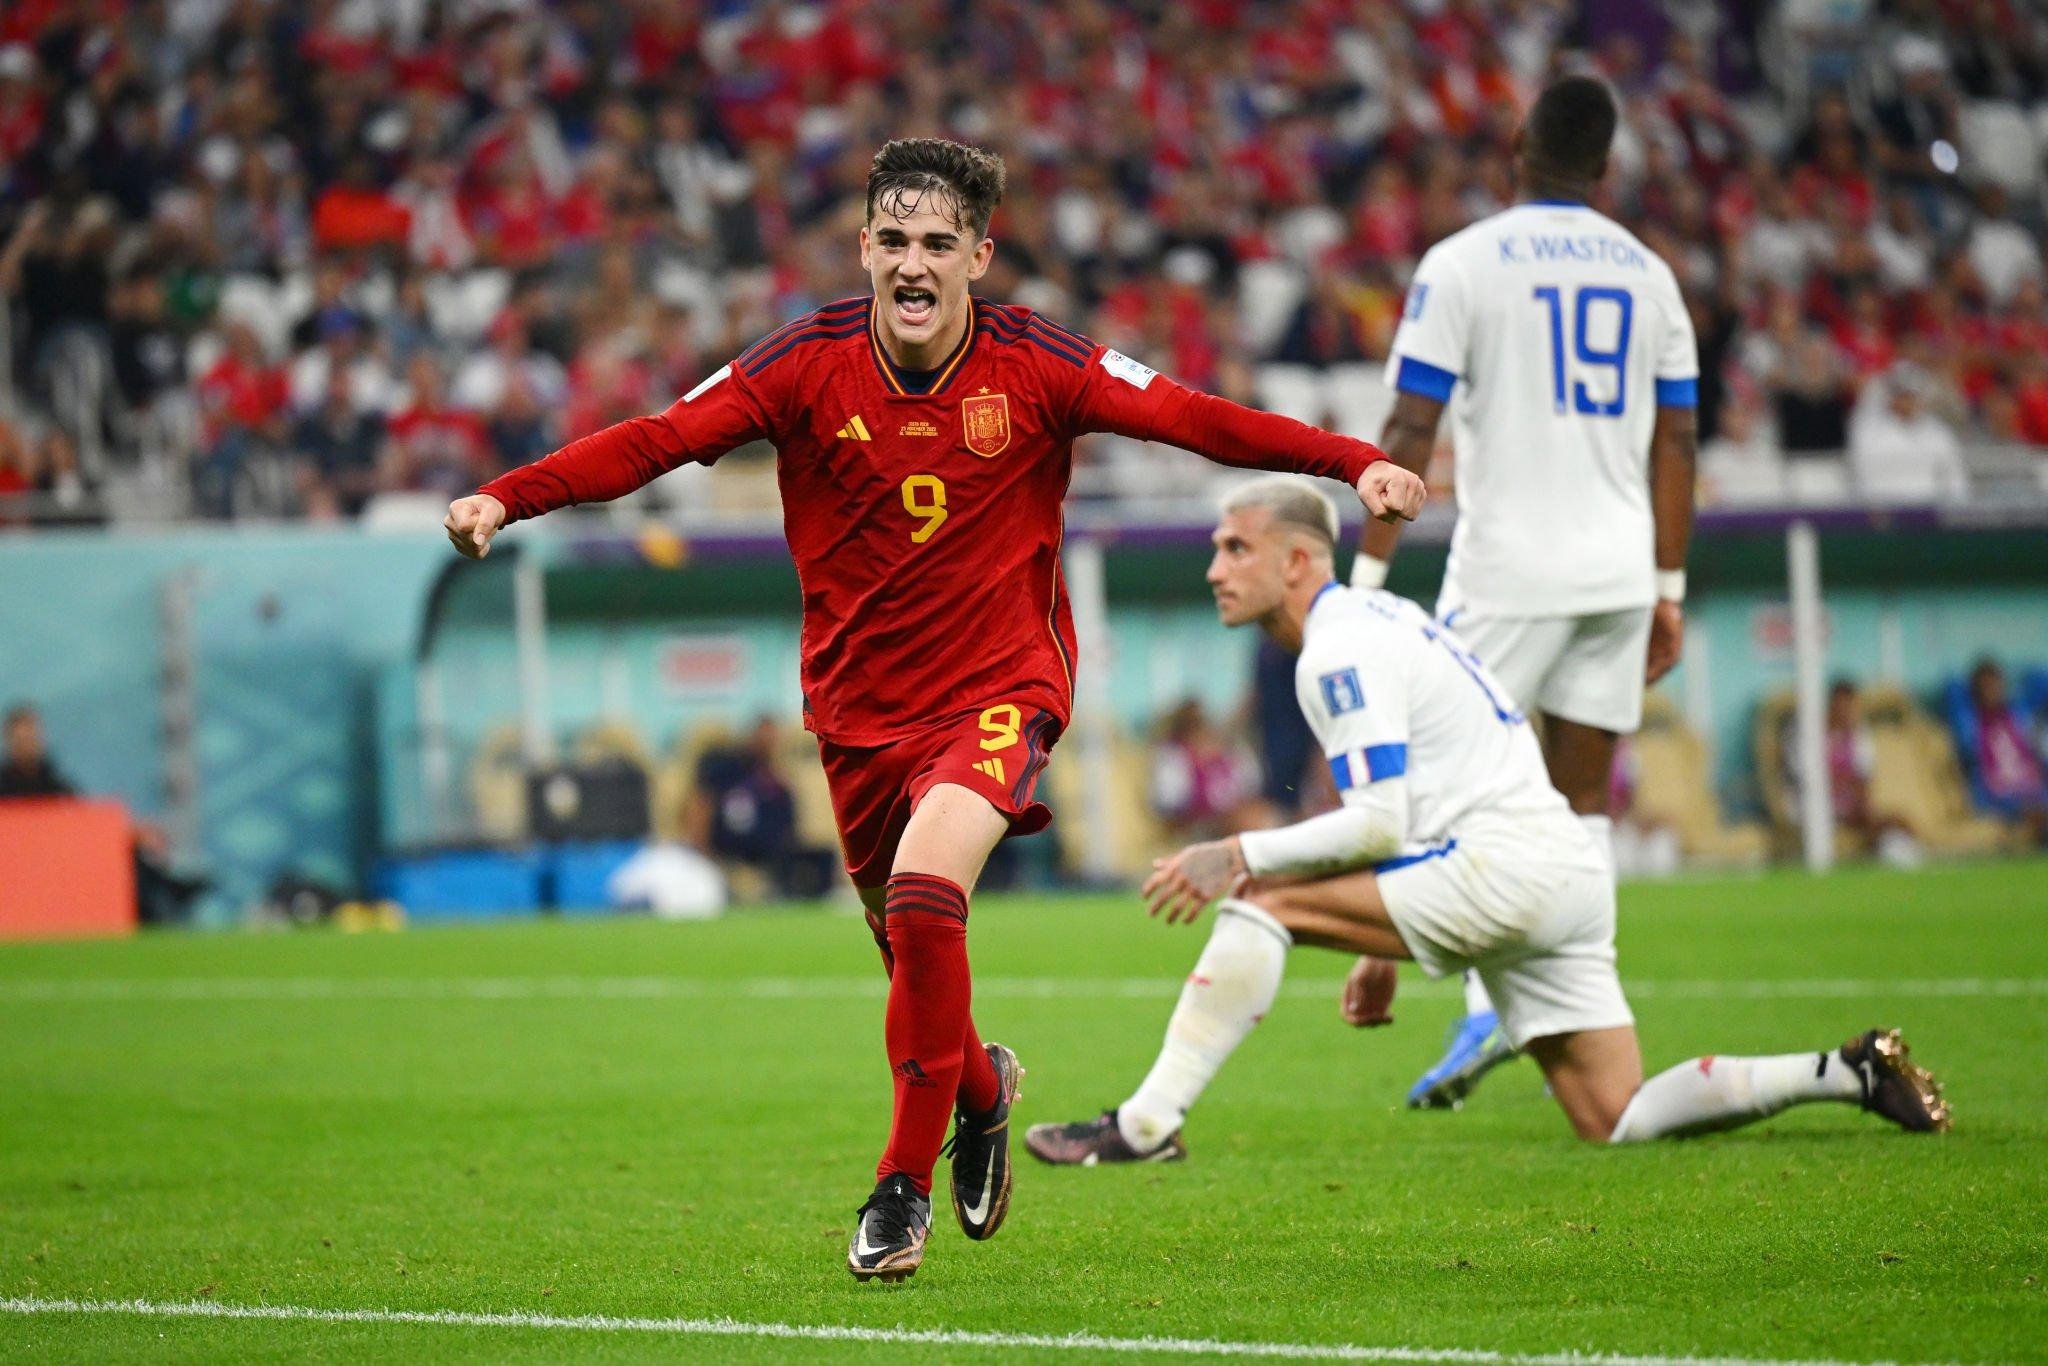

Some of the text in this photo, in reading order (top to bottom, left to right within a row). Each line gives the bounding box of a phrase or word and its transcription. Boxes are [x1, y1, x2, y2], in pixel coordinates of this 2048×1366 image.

[1534, 286, 1634, 417] 19
[901, 474, 948, 544] 9
[978, 704, 1022, 752] 9
